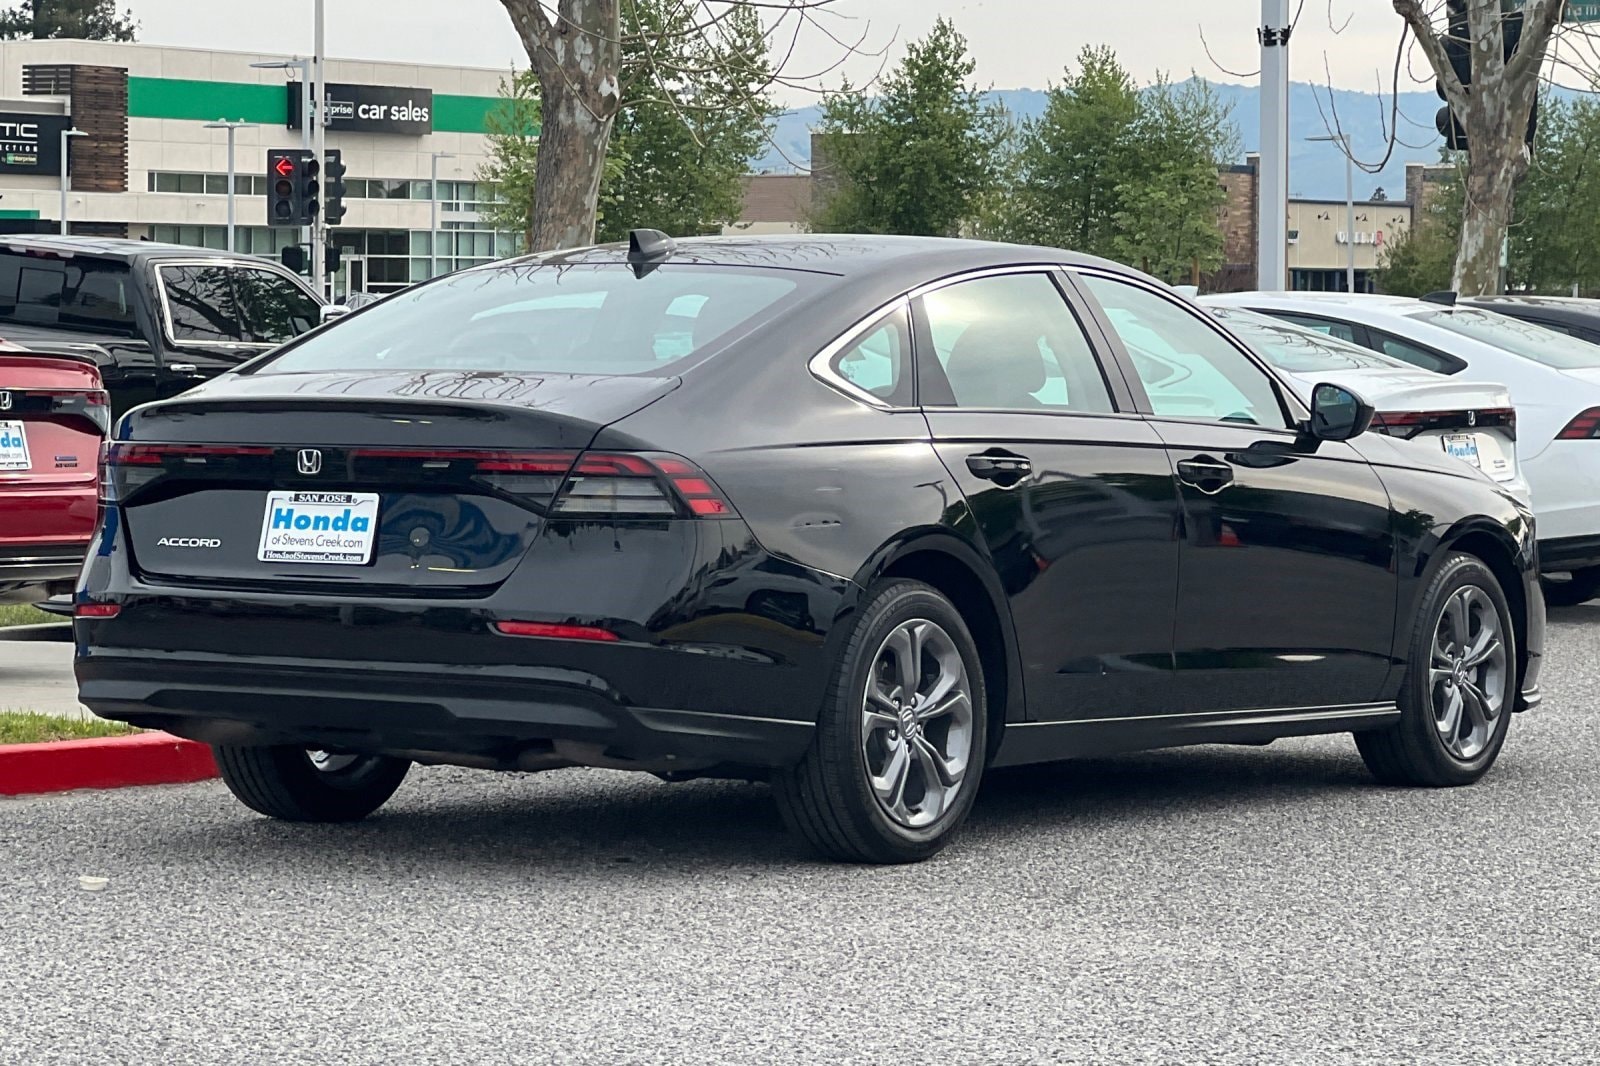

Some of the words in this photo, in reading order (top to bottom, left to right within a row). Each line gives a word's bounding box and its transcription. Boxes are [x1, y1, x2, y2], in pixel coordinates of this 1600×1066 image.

[358, 104, 387, 120] car
[390, 99, 429, 122] sales
[1447, 442, 1477, 457] Honda
[298, 494, 320, 503] SAN
[321, 494, 348, 503] JOSE
[272, 508, 370, 532] Honda
[157, 537, 222, 548] ACCORD
[271, 533, 282, 545] of
[282, 533, 314, 547] Stevens
[315, 534, 363, 549] Creek.com
[265, 550, 362, 562] HondaofStevensCreek.com
